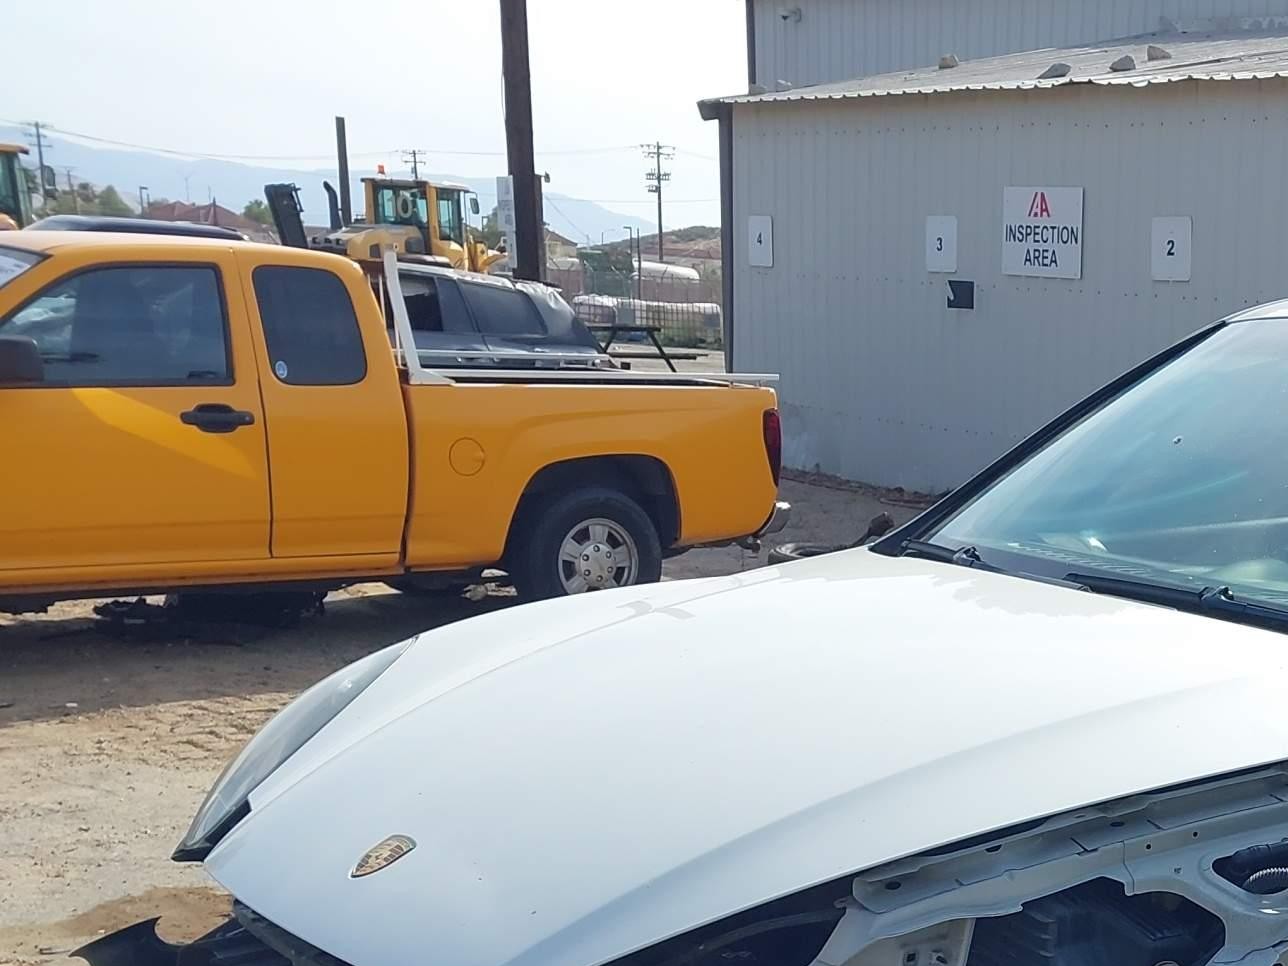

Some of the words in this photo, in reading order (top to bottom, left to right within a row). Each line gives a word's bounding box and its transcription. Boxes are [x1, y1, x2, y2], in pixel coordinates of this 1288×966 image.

[756, 231, 763, 246] 4
[1005, 224, 1079, 245] INSPECTION
[936, 237, 943, 252] 3
[1166, 239, 1175, 257] 2
[1023, 248, 1058, 268] AREA
